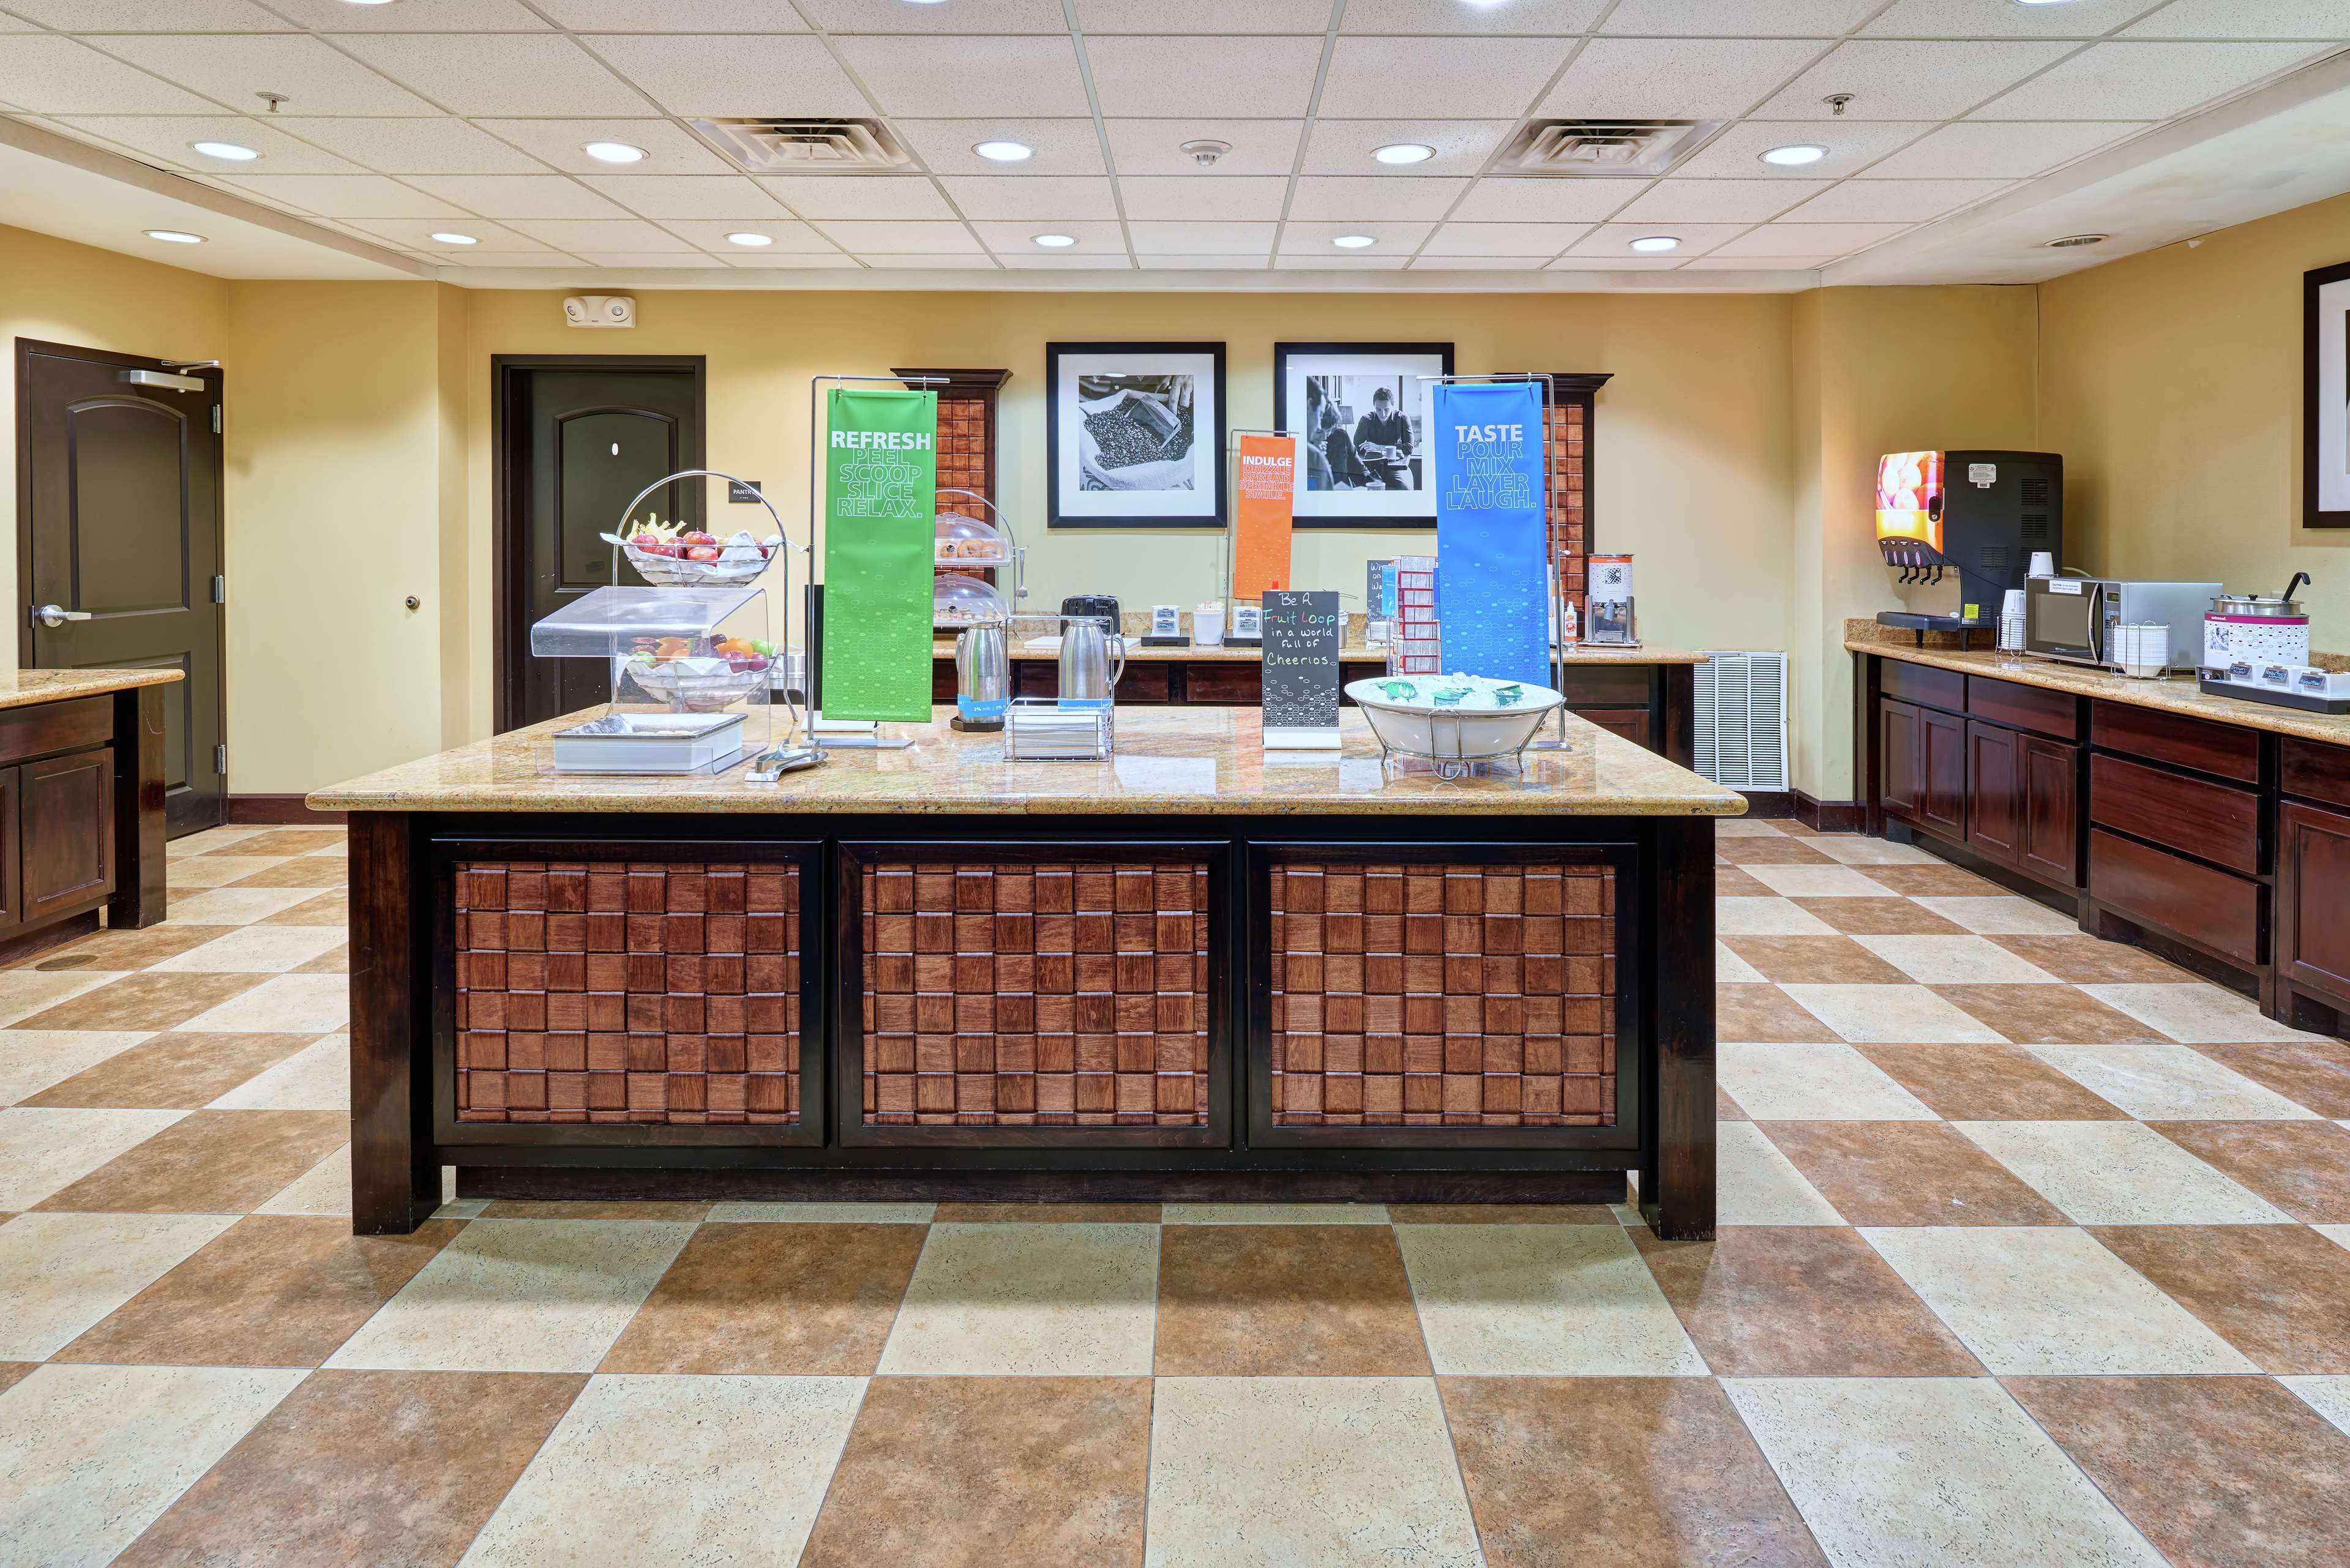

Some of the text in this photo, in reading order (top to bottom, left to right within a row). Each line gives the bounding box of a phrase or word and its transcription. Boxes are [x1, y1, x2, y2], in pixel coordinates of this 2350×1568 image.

[831, 431, 930, 450] REFRESH
[1455, 424, 1523, 442] TASTE
[853, 447, 910, 466] PEEL
[1458, 440, 1523, 459] POUR
[1243, 455, 1292, 467] INDULGE
[1244, 465, 1291, 474] DRIZZLE
[1467, 457, 1515, 476] MIX
[840, 464, 922, 483] SCOOP
[1243, 472, 1290, 482] SPREAD
[848, 481, 913, 499] SLICE
[1239, 480, 1293, 491] SPRINKLE
[1453, 473, 1529, 493] LAYER
[1246, 490, 1286, 500] SMILE.
[1446, 490, 1536, 510] LAUGH.
[837, 498, 922, 518] RELAX.
[1279, 592, 1298, 606] Be
[1263, 609, 1297, 625] Fruit
[1271, 628, 1282, 637] in
[1301, 628, 1333, 637] world
[1306, 639, 1319, 648] of
[1267, 652, 1328, 666] Cheerios
